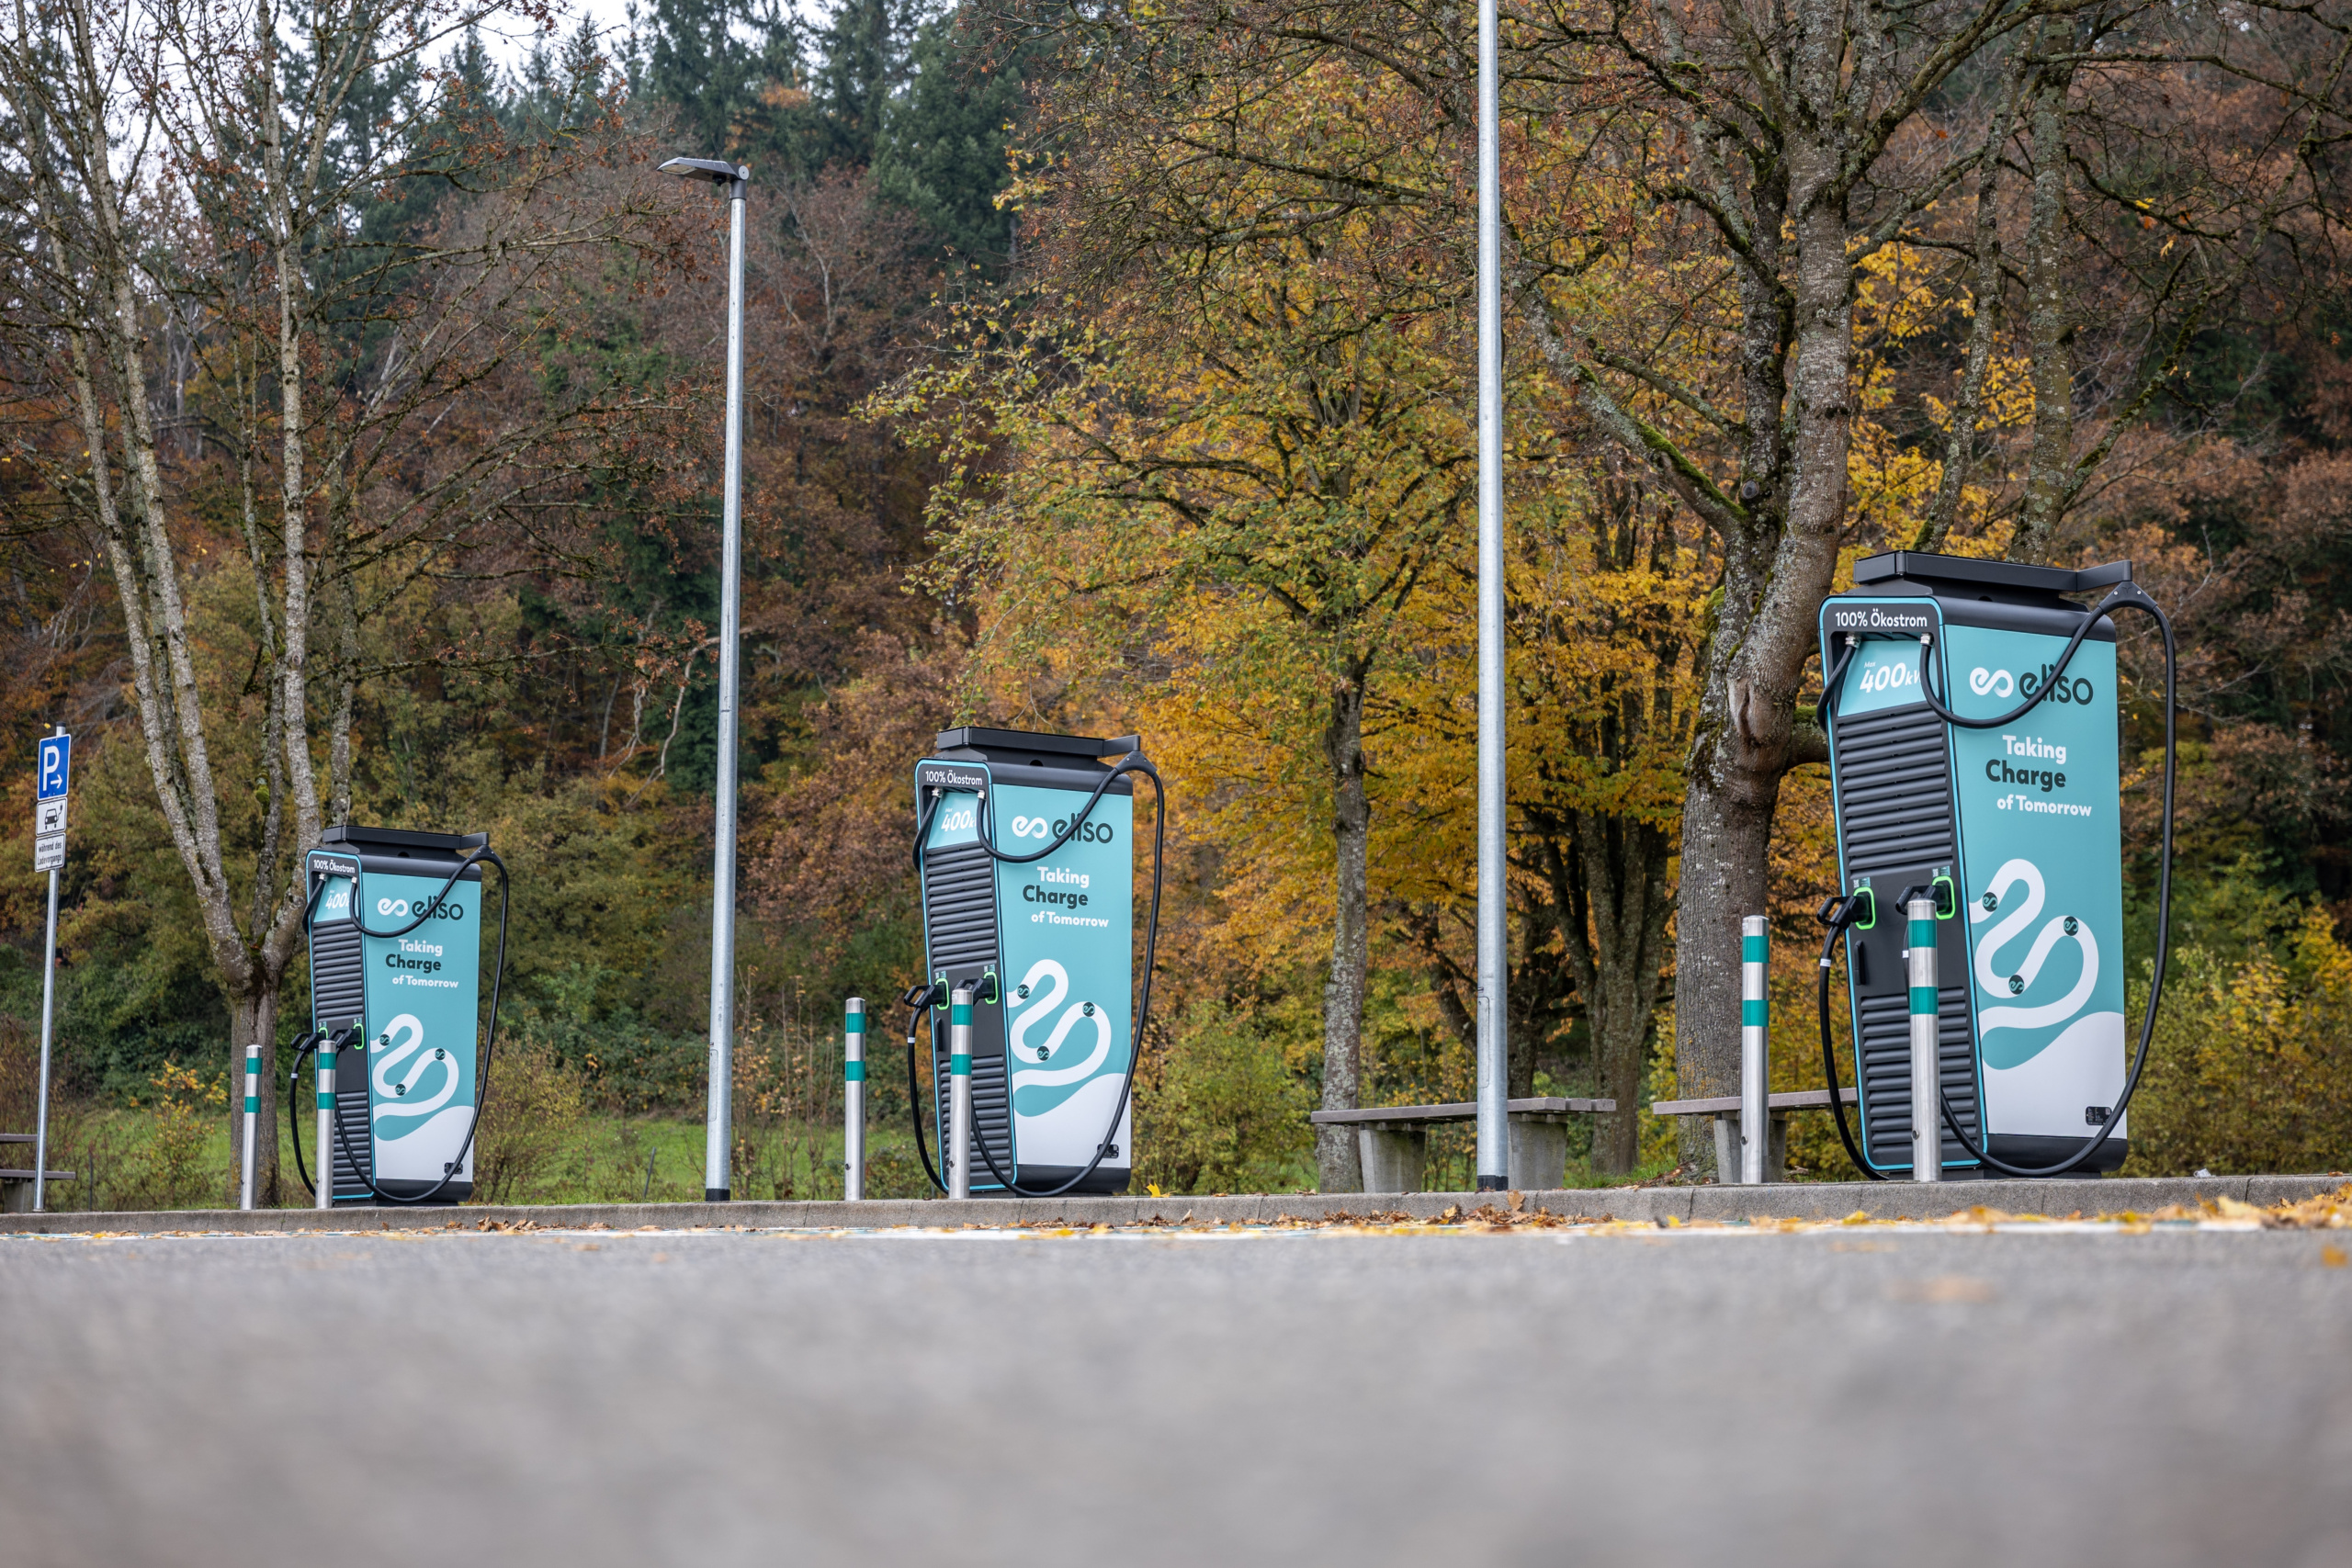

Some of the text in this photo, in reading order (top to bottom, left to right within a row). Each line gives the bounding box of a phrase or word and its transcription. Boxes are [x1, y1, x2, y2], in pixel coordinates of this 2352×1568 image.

[1836, 607, 1928, 627] 100% Ökostrom
[2002, 735, 2066, 764] Taking
[42, 745, 60, 792] P
[925, 770, 982, 785] 100% Ökostrom
[1985, 759, 2066, 793] Charge
[1996, 794, 2092, 817] of Tomorrow
[941, 809, 977, 832] 400k
[39, 841, 53, 852] während
[313, 859, 356, 874] 100% Ökostrom
[1037, 866, 1090, 888] Taking
[1023, 885, 1089, 909] Charge
[1031, 910, 1109, 928] of Tomorrow
[398, 938, 443, 957] Taking
[386, 953, 442, 974] Charge
[392, 975, 459, 988] of Tomorrow
